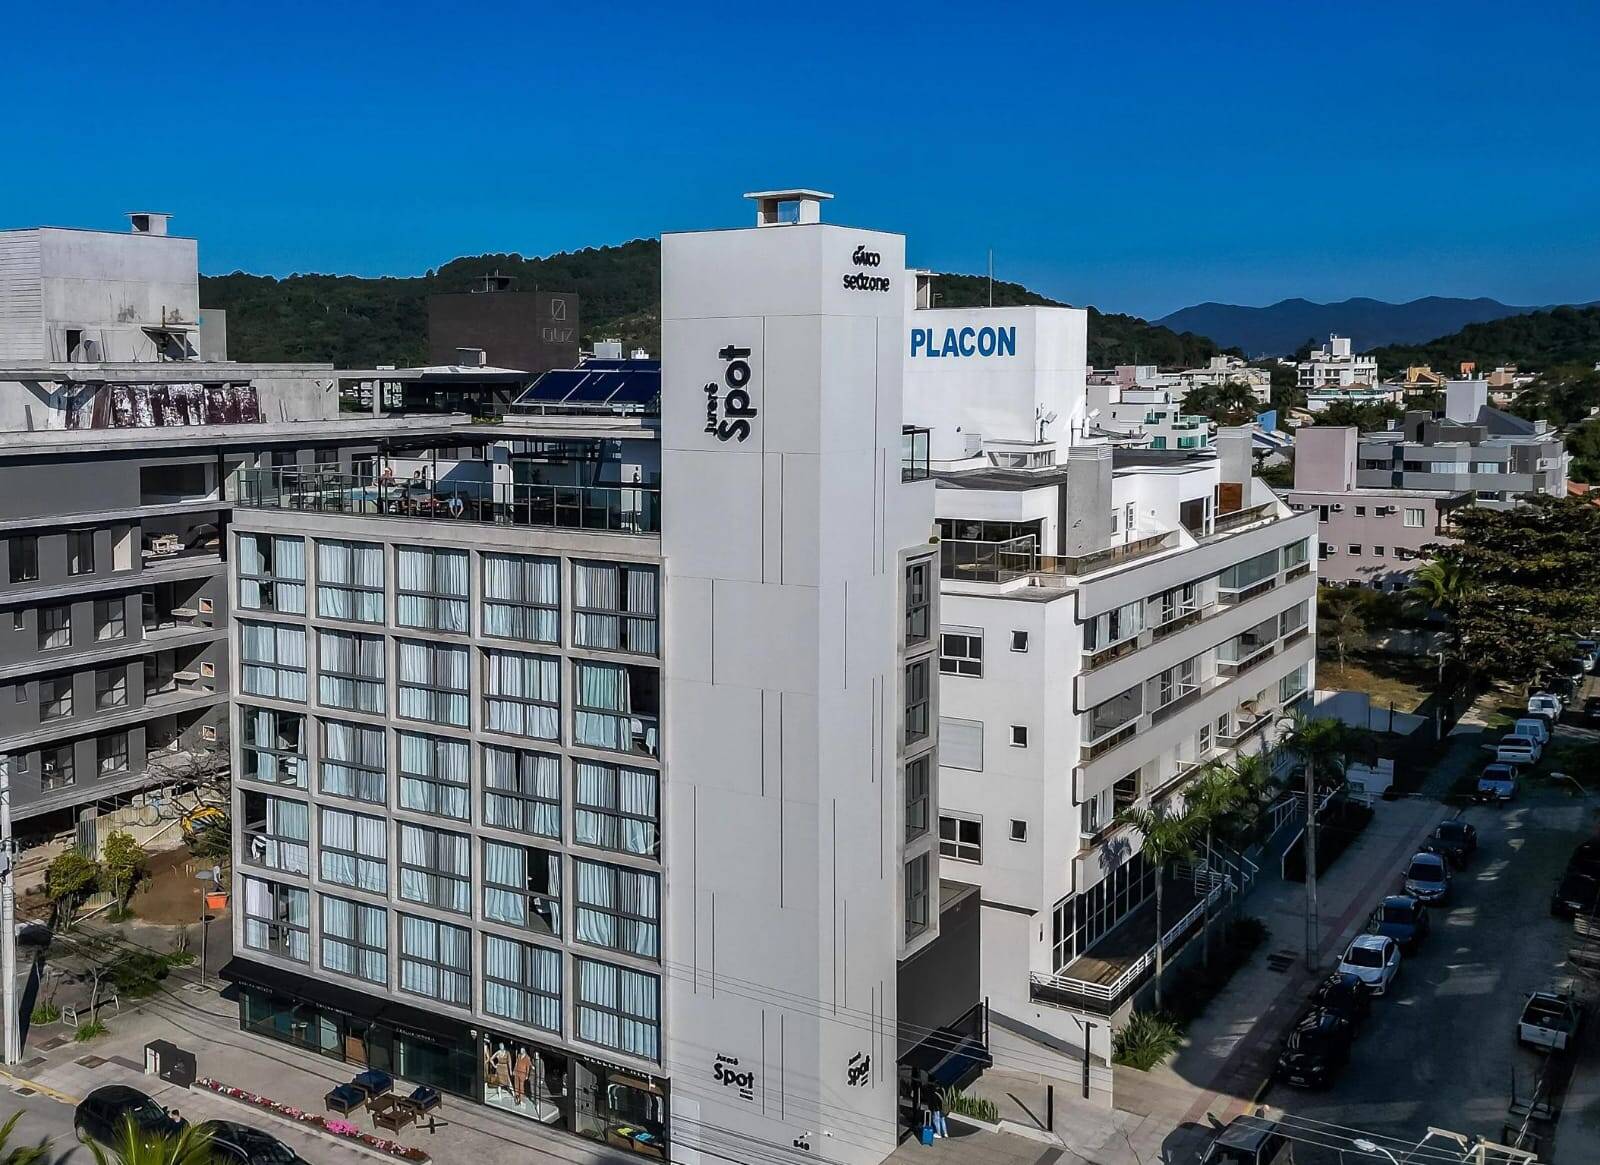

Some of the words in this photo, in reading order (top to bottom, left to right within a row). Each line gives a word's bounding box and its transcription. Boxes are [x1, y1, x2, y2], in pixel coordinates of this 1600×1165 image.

[910, 327, 1016, 358] PLACON
[717, 344, 758, 443] Spot
[713, 1062, 755, 1089] Spot
